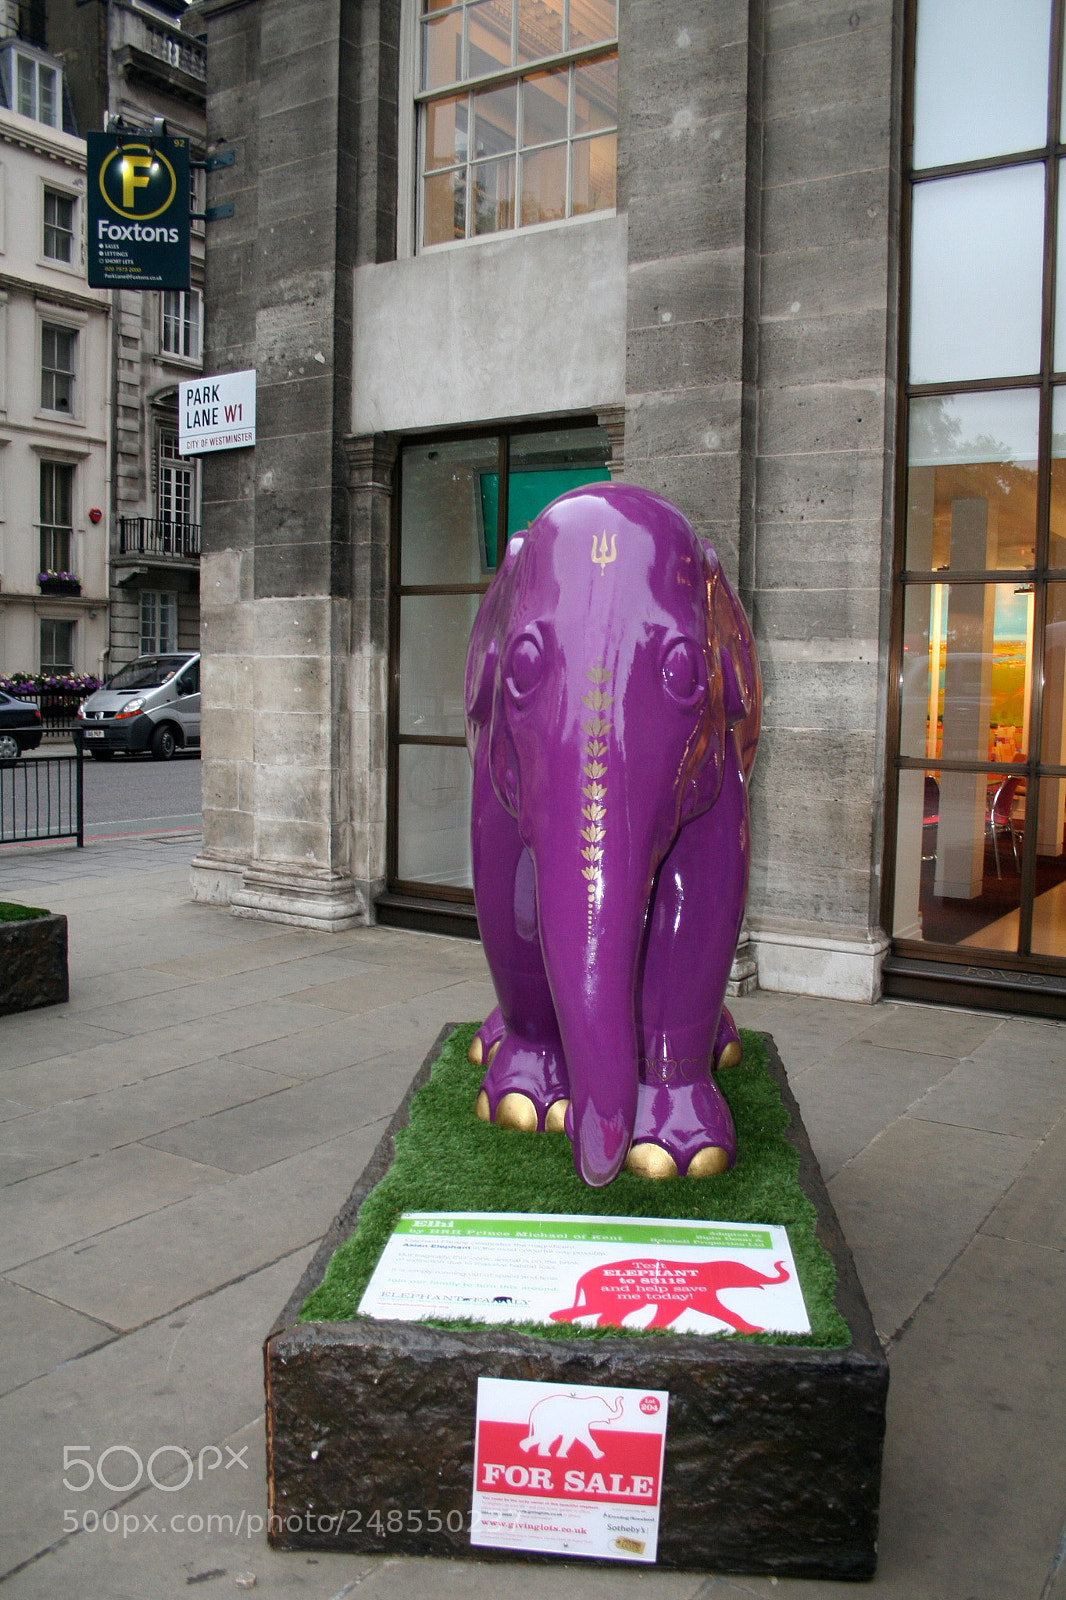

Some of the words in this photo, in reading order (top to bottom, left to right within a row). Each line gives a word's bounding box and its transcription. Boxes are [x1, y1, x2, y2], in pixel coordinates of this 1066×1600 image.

[174, 139, 185, 148] 92
[122, 155, 153, 208] F
[98, 219, 179, 243] Foxtons
[186, 384, 220, 407] PARK
[186, 407, 219, 429] LANE
[224, 403, 243, 423] W1
[186, 439, 199, 450] CITY
[200, 438, 208, 447] OF
[209, 431, 253, 446] WESTMINSTER
[515, 1231, 568, 1239] Michael
[631, 1262, 668, 1270] Text
[602, 1269, 700, 1277] ELEPHANT
[636, 1285, 669, 1294] help
[381, 1291, 464, 1302] ELEPHANT
[646, 1292, 694, 1302] today!
[482, 1462, 554, 1490] FOR
[563, 1469, 654, 1498] SALE
[481, 1519, 587, 1535] www.givinglots.co.uk
[606, 1523, 646, 1534] Sotheby's
